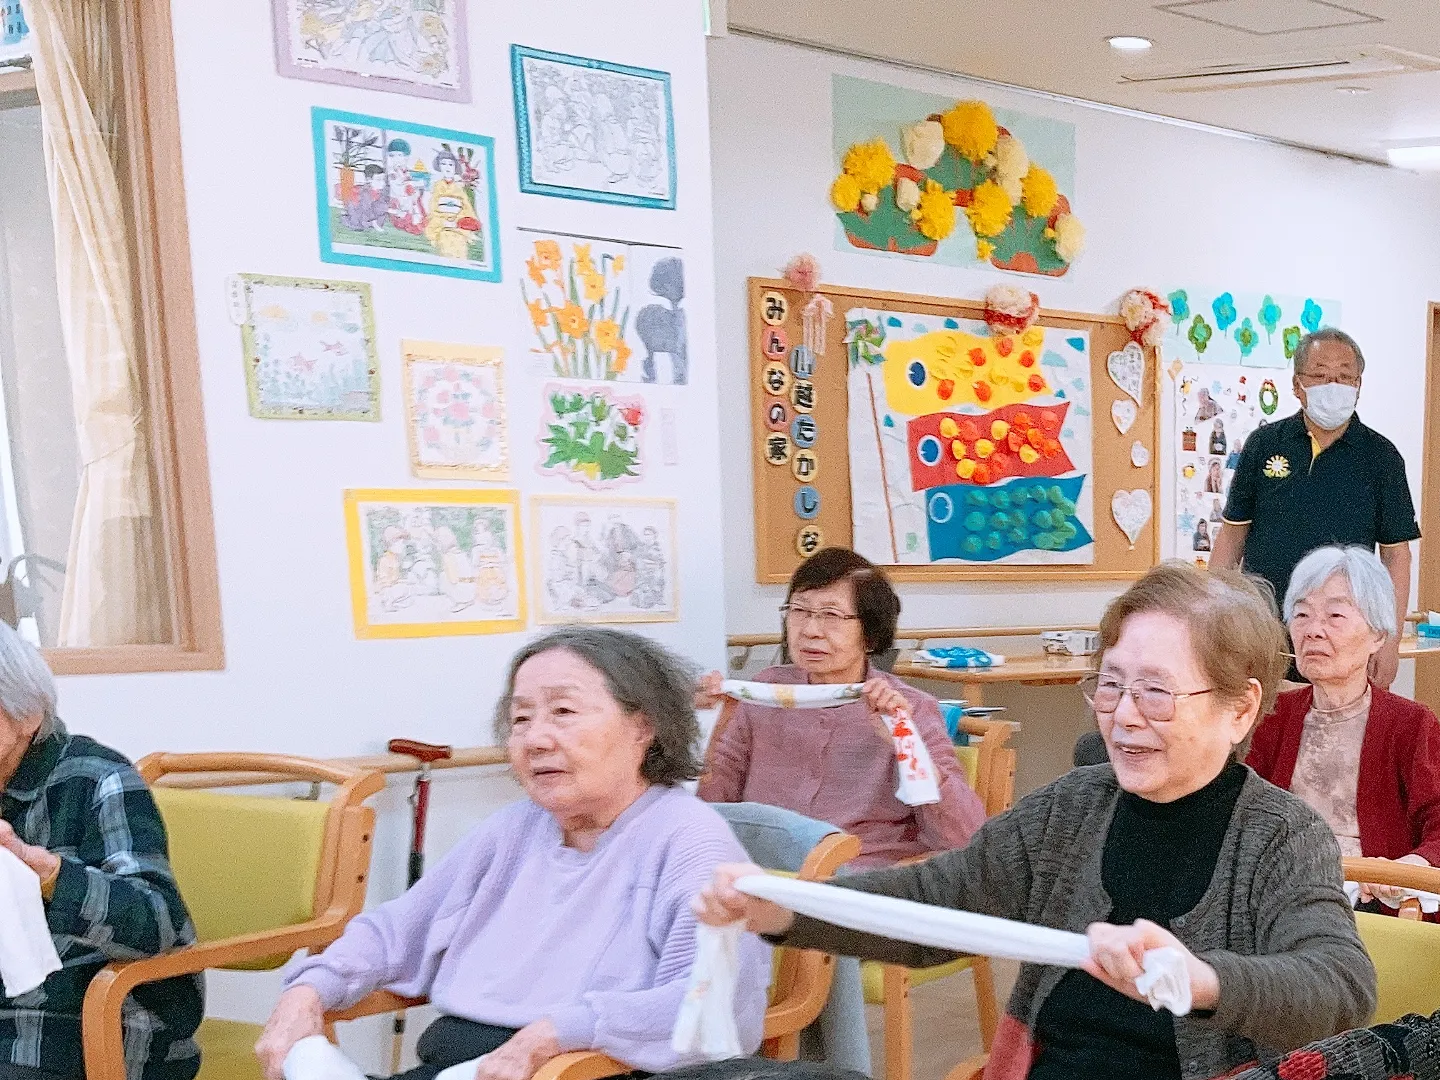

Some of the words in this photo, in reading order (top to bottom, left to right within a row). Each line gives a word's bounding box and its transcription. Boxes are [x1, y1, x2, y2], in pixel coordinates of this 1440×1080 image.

[764, 297, 789, 461] みんなの家
